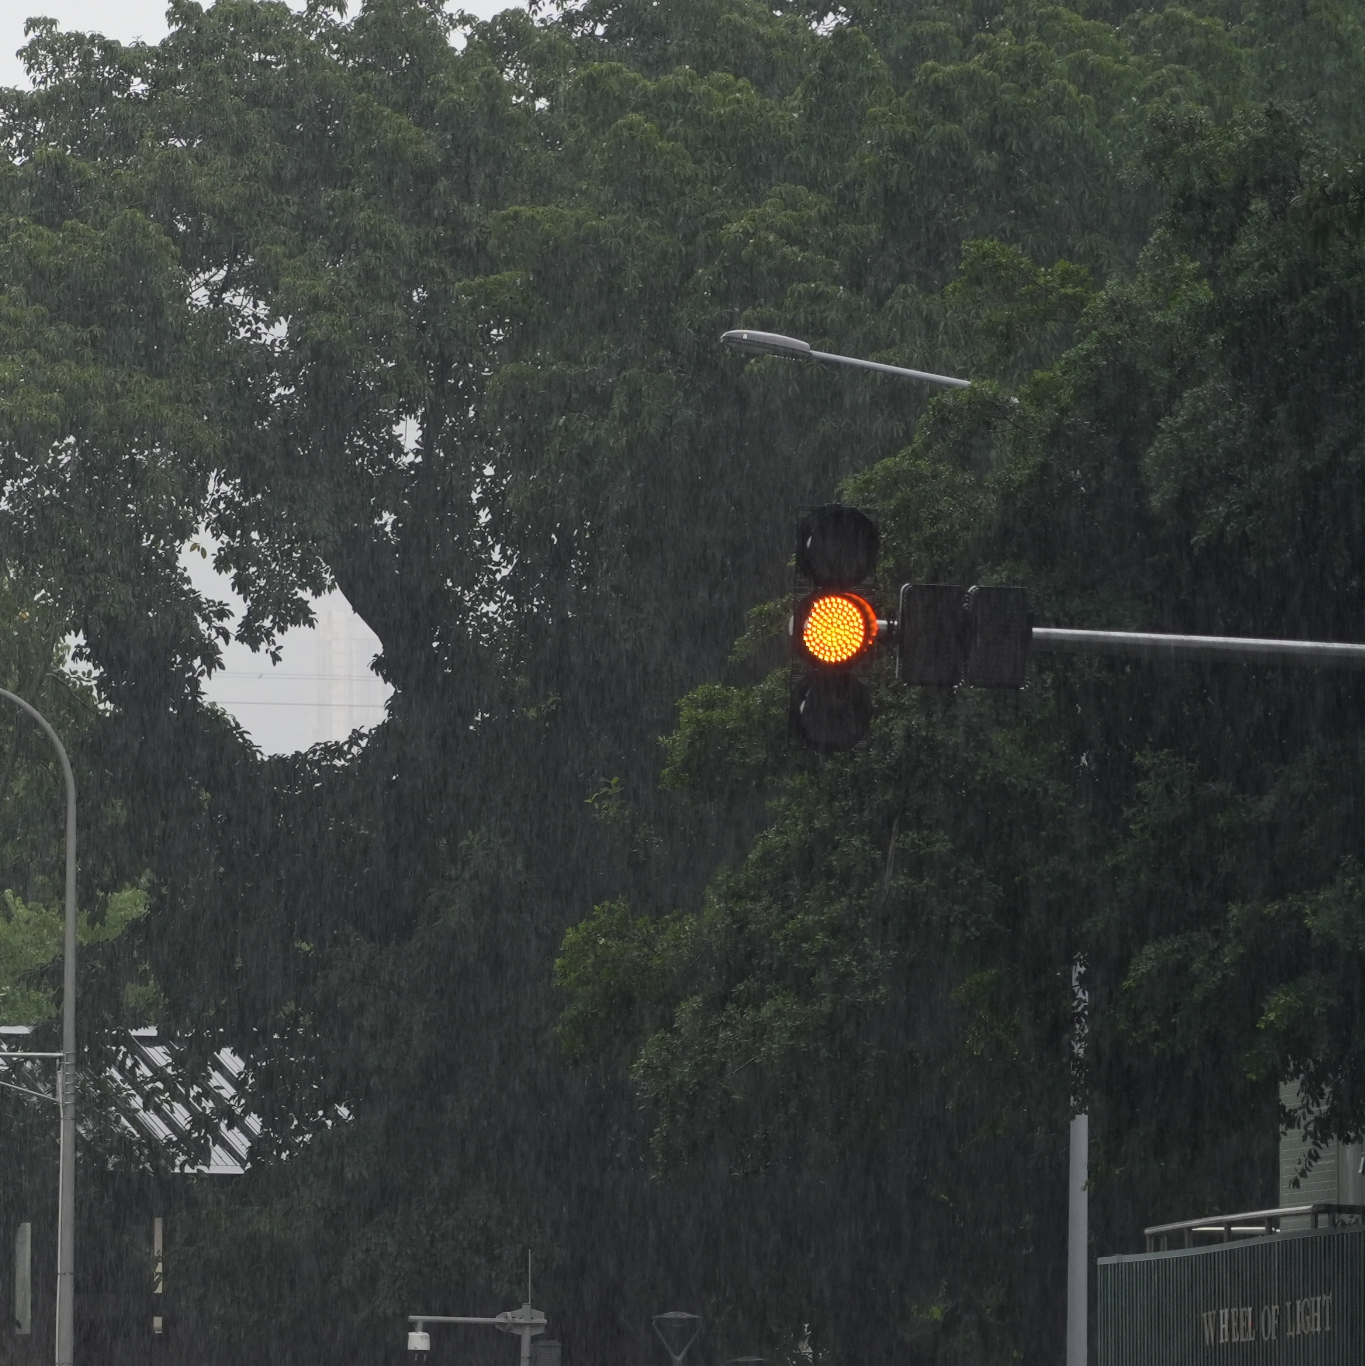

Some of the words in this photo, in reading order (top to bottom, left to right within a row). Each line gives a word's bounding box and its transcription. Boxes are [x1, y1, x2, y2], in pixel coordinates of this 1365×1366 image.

[1202, 1307, 1256, 1347] WHEEL
[1261, 1304, 1279, 1341] OF
[1286, 1293, 1332, 1338] LIGHT
